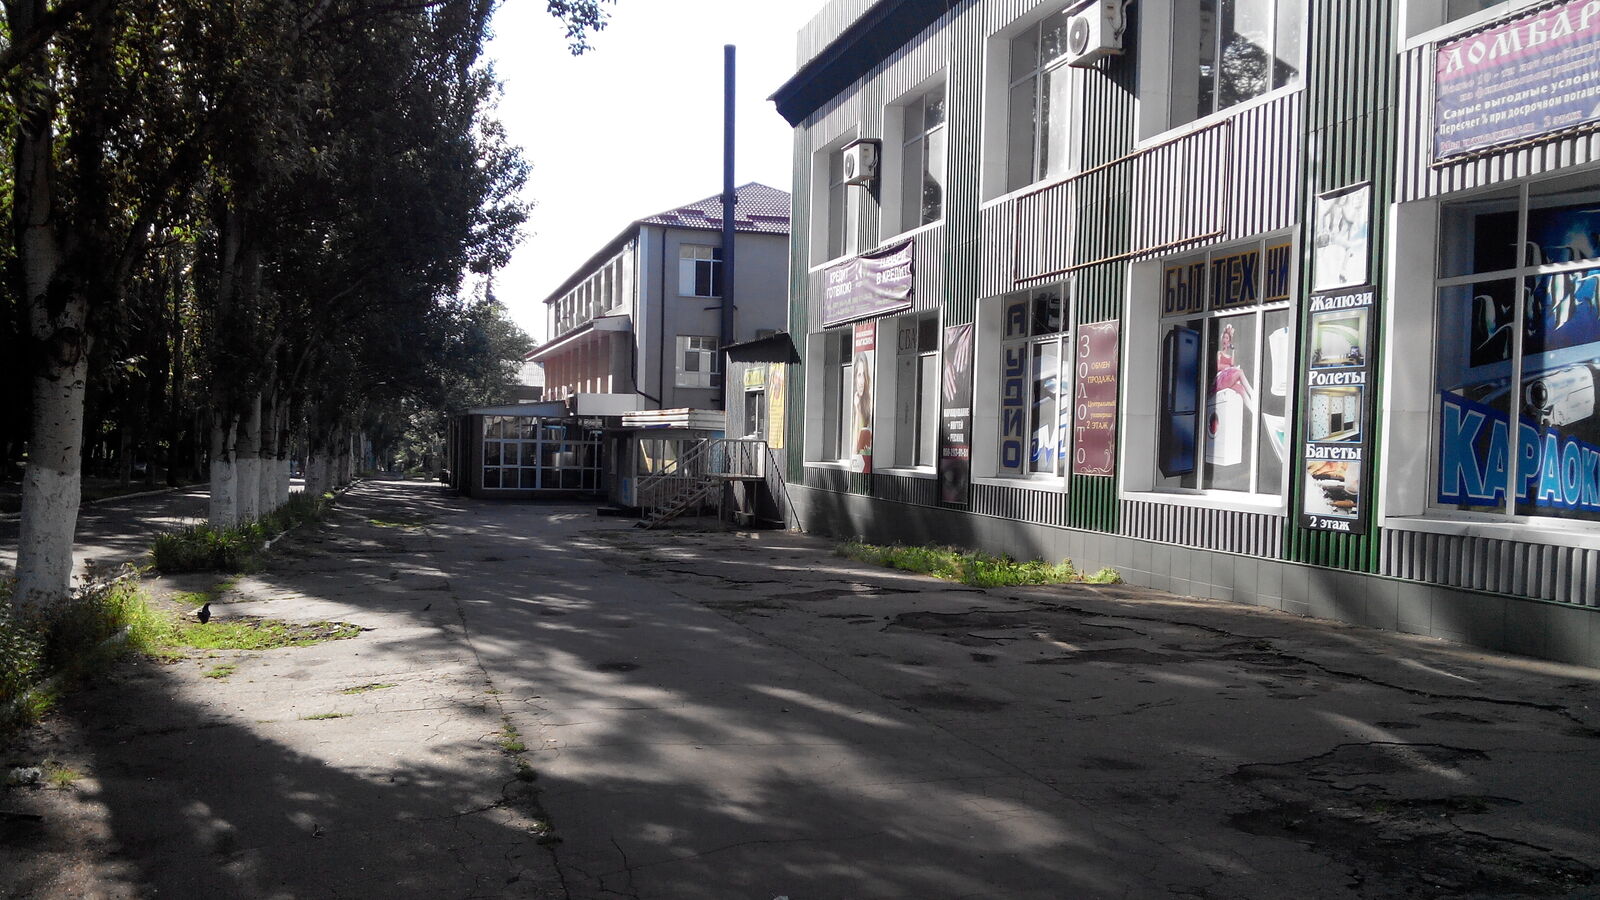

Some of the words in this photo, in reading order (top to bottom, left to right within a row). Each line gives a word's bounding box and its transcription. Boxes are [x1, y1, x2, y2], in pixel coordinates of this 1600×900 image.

[1443, 103, 1482, 120] Самые
[1484, 84, 1548, 109] выгодные
[1440, 117, 1481, 135] Пересчет
[1489, 108, 1507, 124] при
[1507, 97, 1562, 118] досрочном
[830, 269, 848, 283] КРЕДИТ
[1310, 292, 1373, 312] Жалюзи
[1091, 361, 1110, 370] ОБМЕН
[1002, 302, 1027, 469] АУДИО
[1087, 375, 1115, 384] ПРОДАЖА
[1308, 371, 1367, 386] Ролеты
[1077, 335, 1090, 464] ЗОЛОТО
[1086, 420, 1091, 429] 2
[1091, 421, 1109, 429] ЭТАЖ
[1305, 444, 1362, 460] Багеты
[1442, 401, 1600, 505] КАРАОК
[1309, 516, 1317, 527] 2
[1320, 519, 1350, 531] этаж
